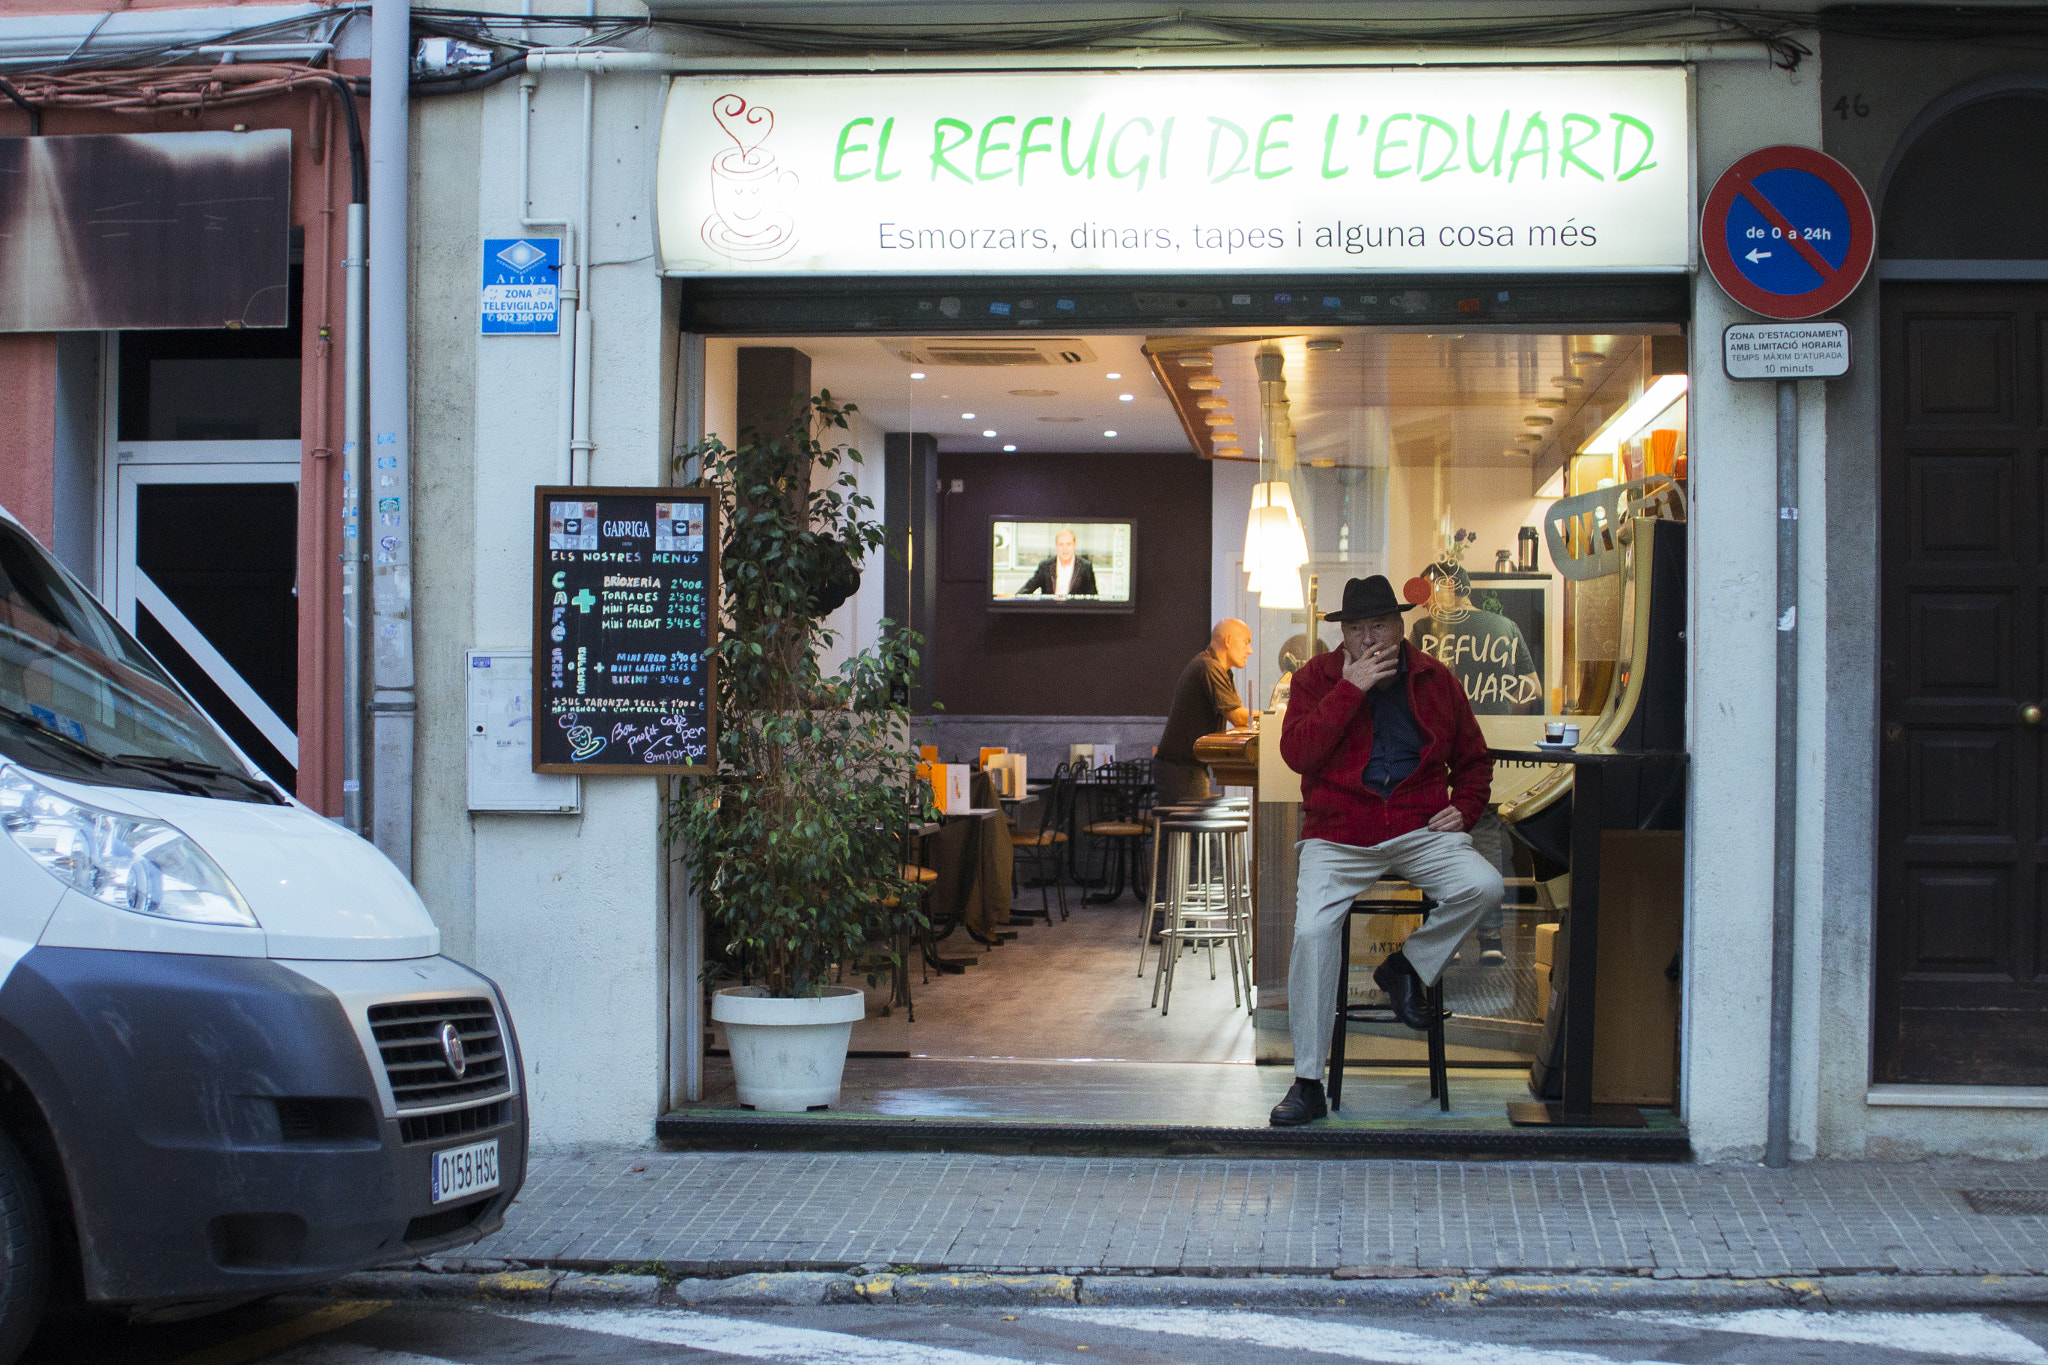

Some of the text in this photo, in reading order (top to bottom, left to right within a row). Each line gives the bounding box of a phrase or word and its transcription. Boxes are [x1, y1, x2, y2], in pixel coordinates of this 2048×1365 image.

[1833, 94, 1870, 120] 46
[833, 109, 1658, 191] EL REFUGI DE L'EDUARD
[879, 218, 1597, 254] Esmorzars, dinars, tapes i alguna cosa més
[1746, 226, 1765, 239] de
[1788, 229, 1797, 240] a
[1803, 227, 1831, 240] 24h
[496, 274, 546, 285] Artys
[505, 289, 532, 298] ZONA
[483, 301, 554, 311] TELEVIGILADA
[496, 313, 554, 322] 902 360 070
[1730, 330, 1844, 340] ZONA D'ESTACIONAMENT
[1730, 341, 1842, 351] AMB LIMITACIÓ HORARIA
[1765, 364, 1814, 373] 10 minuts
[603, 520, 651, 538] GARRIGA
[551, 551, 575, 562] ELS
[582, 551, 641, 563] NOSTRES
[627, 604, 653, 614] FRED
[626, 618, 661, 629] CALENT
[1421, 633, 1518, 668] REFUGI
[643, 653, 667, 663] FRED
[681, 726, 706, 744] per
[441, 1145, 497, 1194] 0158 HSC
